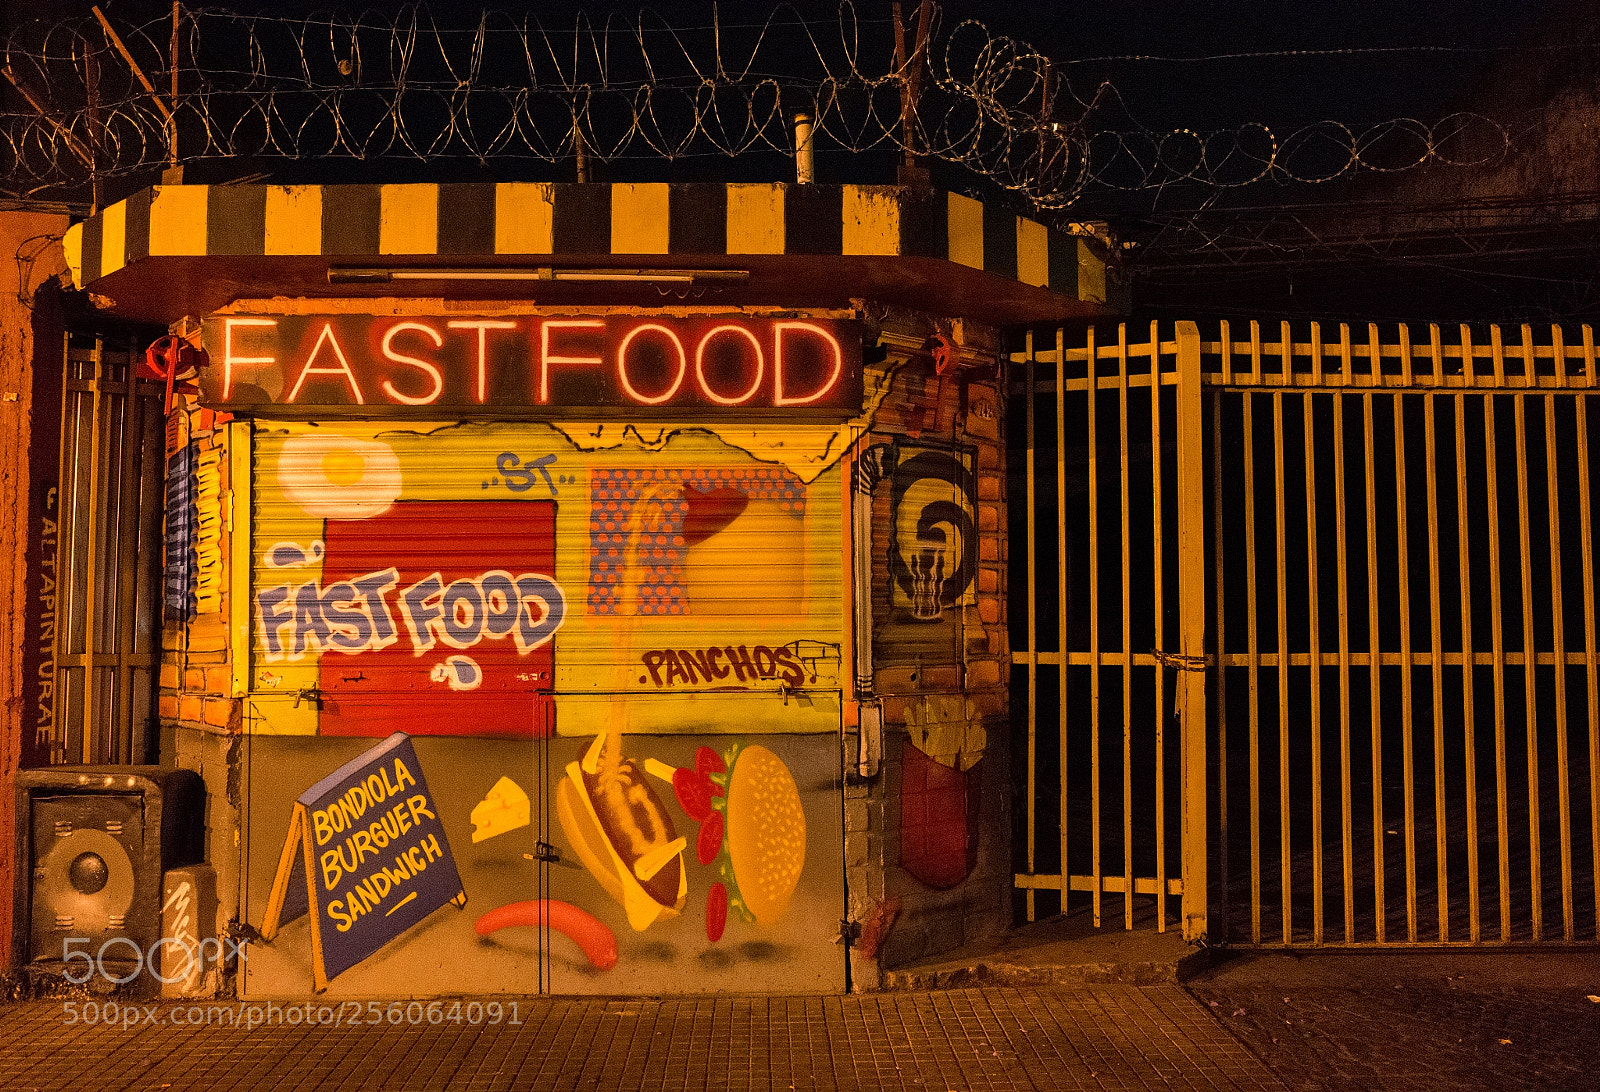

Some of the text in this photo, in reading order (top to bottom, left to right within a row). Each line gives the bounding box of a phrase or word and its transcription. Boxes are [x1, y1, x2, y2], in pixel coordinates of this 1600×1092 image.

[257, 567, 567, 663] FAST FOOD
[312, 758, 416, 846] BONDIOLA
[320, 795, 436, 891] BURGUER
[327, 833, 443, 932] SANDWICH
